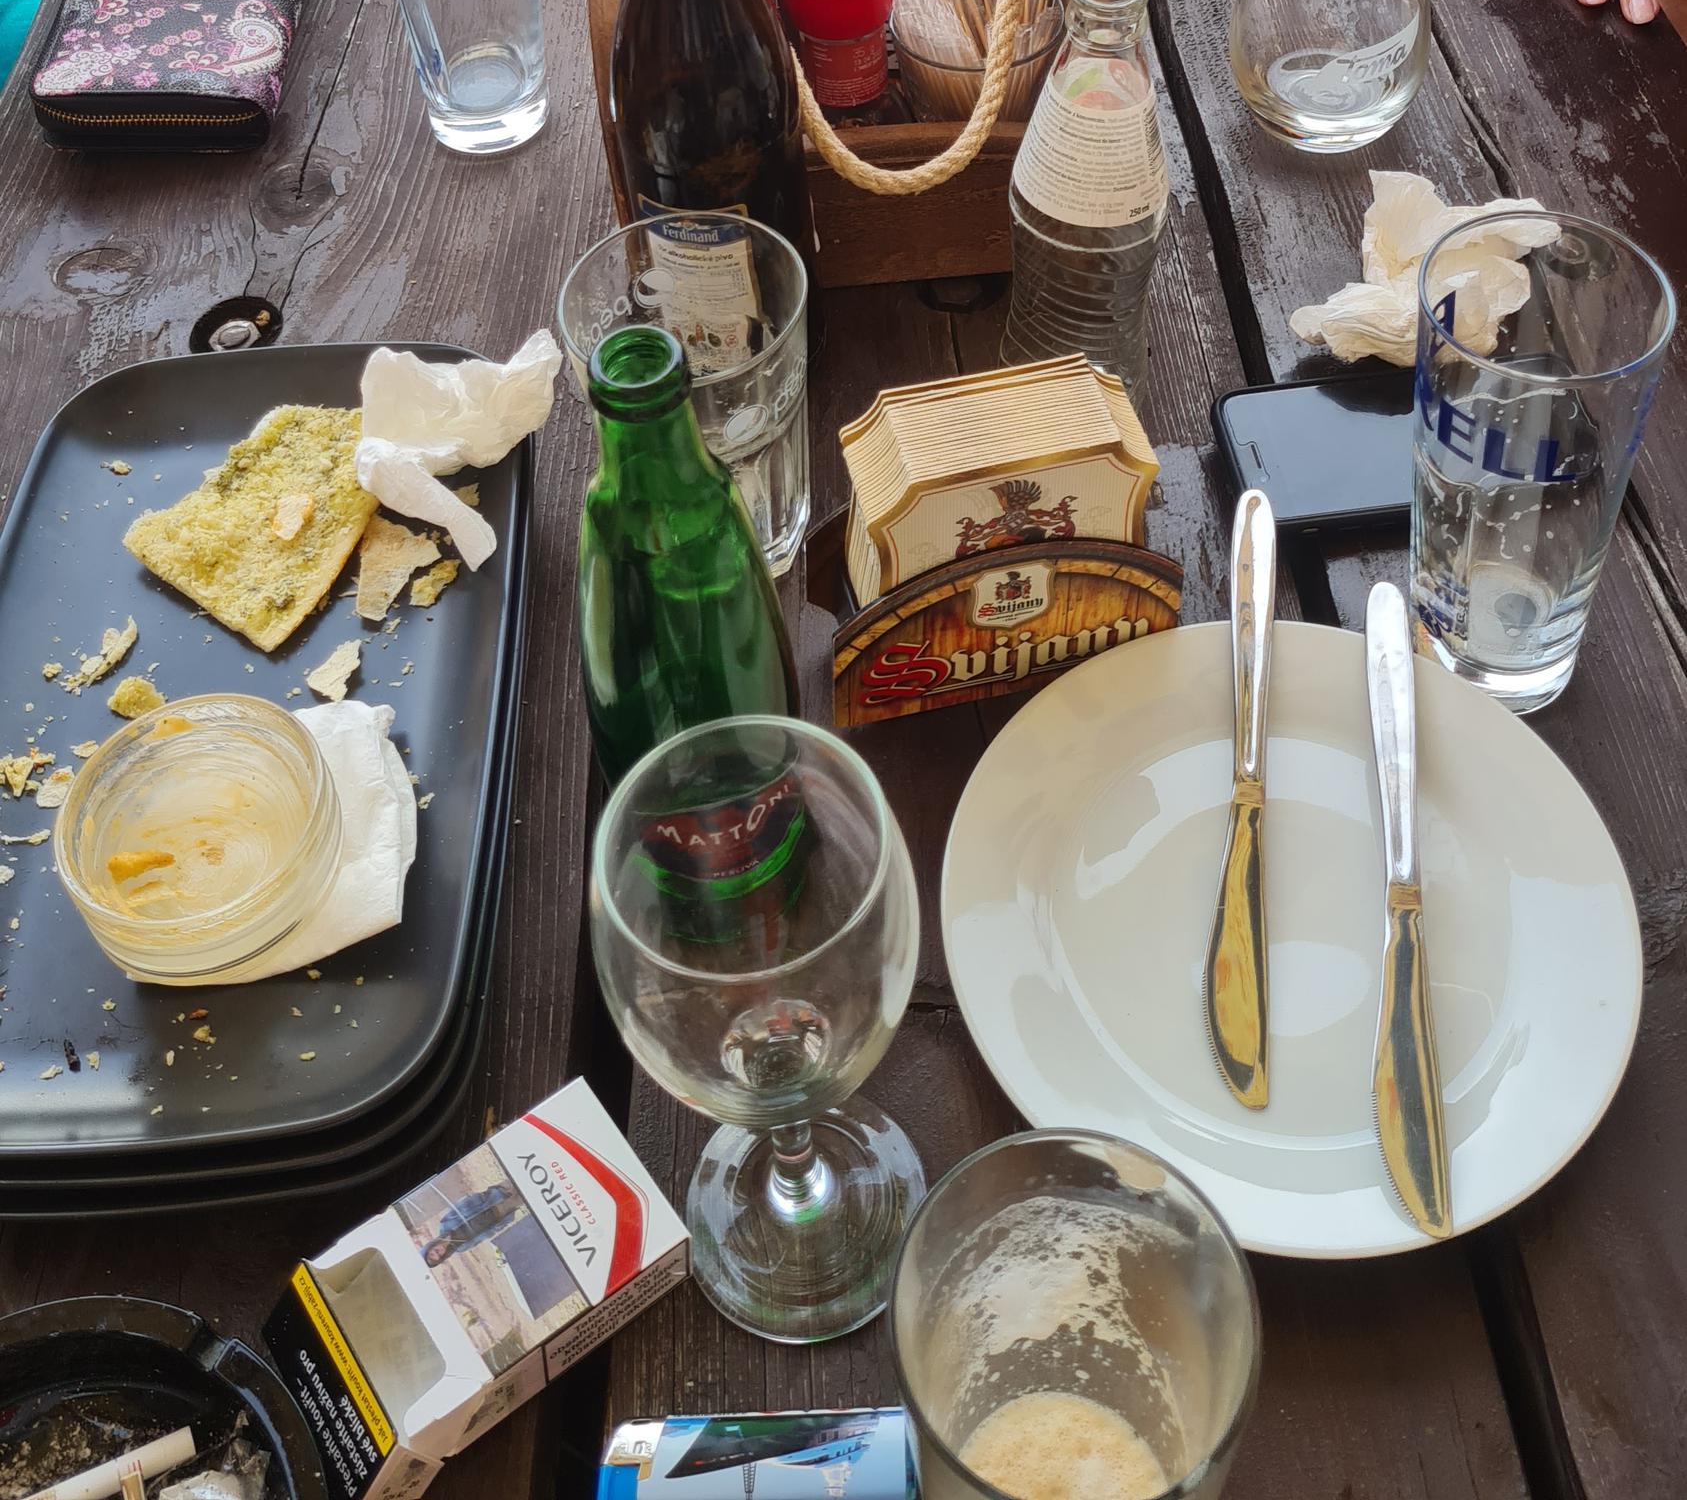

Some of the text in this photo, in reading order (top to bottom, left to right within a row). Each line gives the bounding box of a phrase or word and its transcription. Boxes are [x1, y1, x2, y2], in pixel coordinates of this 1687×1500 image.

[662, 224, 719, 243] Ferdinand
[978, 598, 1044, 619] Svijany
[863, 616, 1150, 706] Svijany
[657, 784, 790, 847] MATTONI
[517, 1152, 597, 1268] VICEROY
[550, 1160, 597, 1226] CLASSIC RED
[299, 1384, 325, 1430] kouřit
[299, 1349, 368, 1481] zůstaňte naživu pro
[336, 1393, 378, 1464] své blízké
[359, 1393, 382, 1426] přestat
[320, 1426, 358, 1498] Přestaňte
